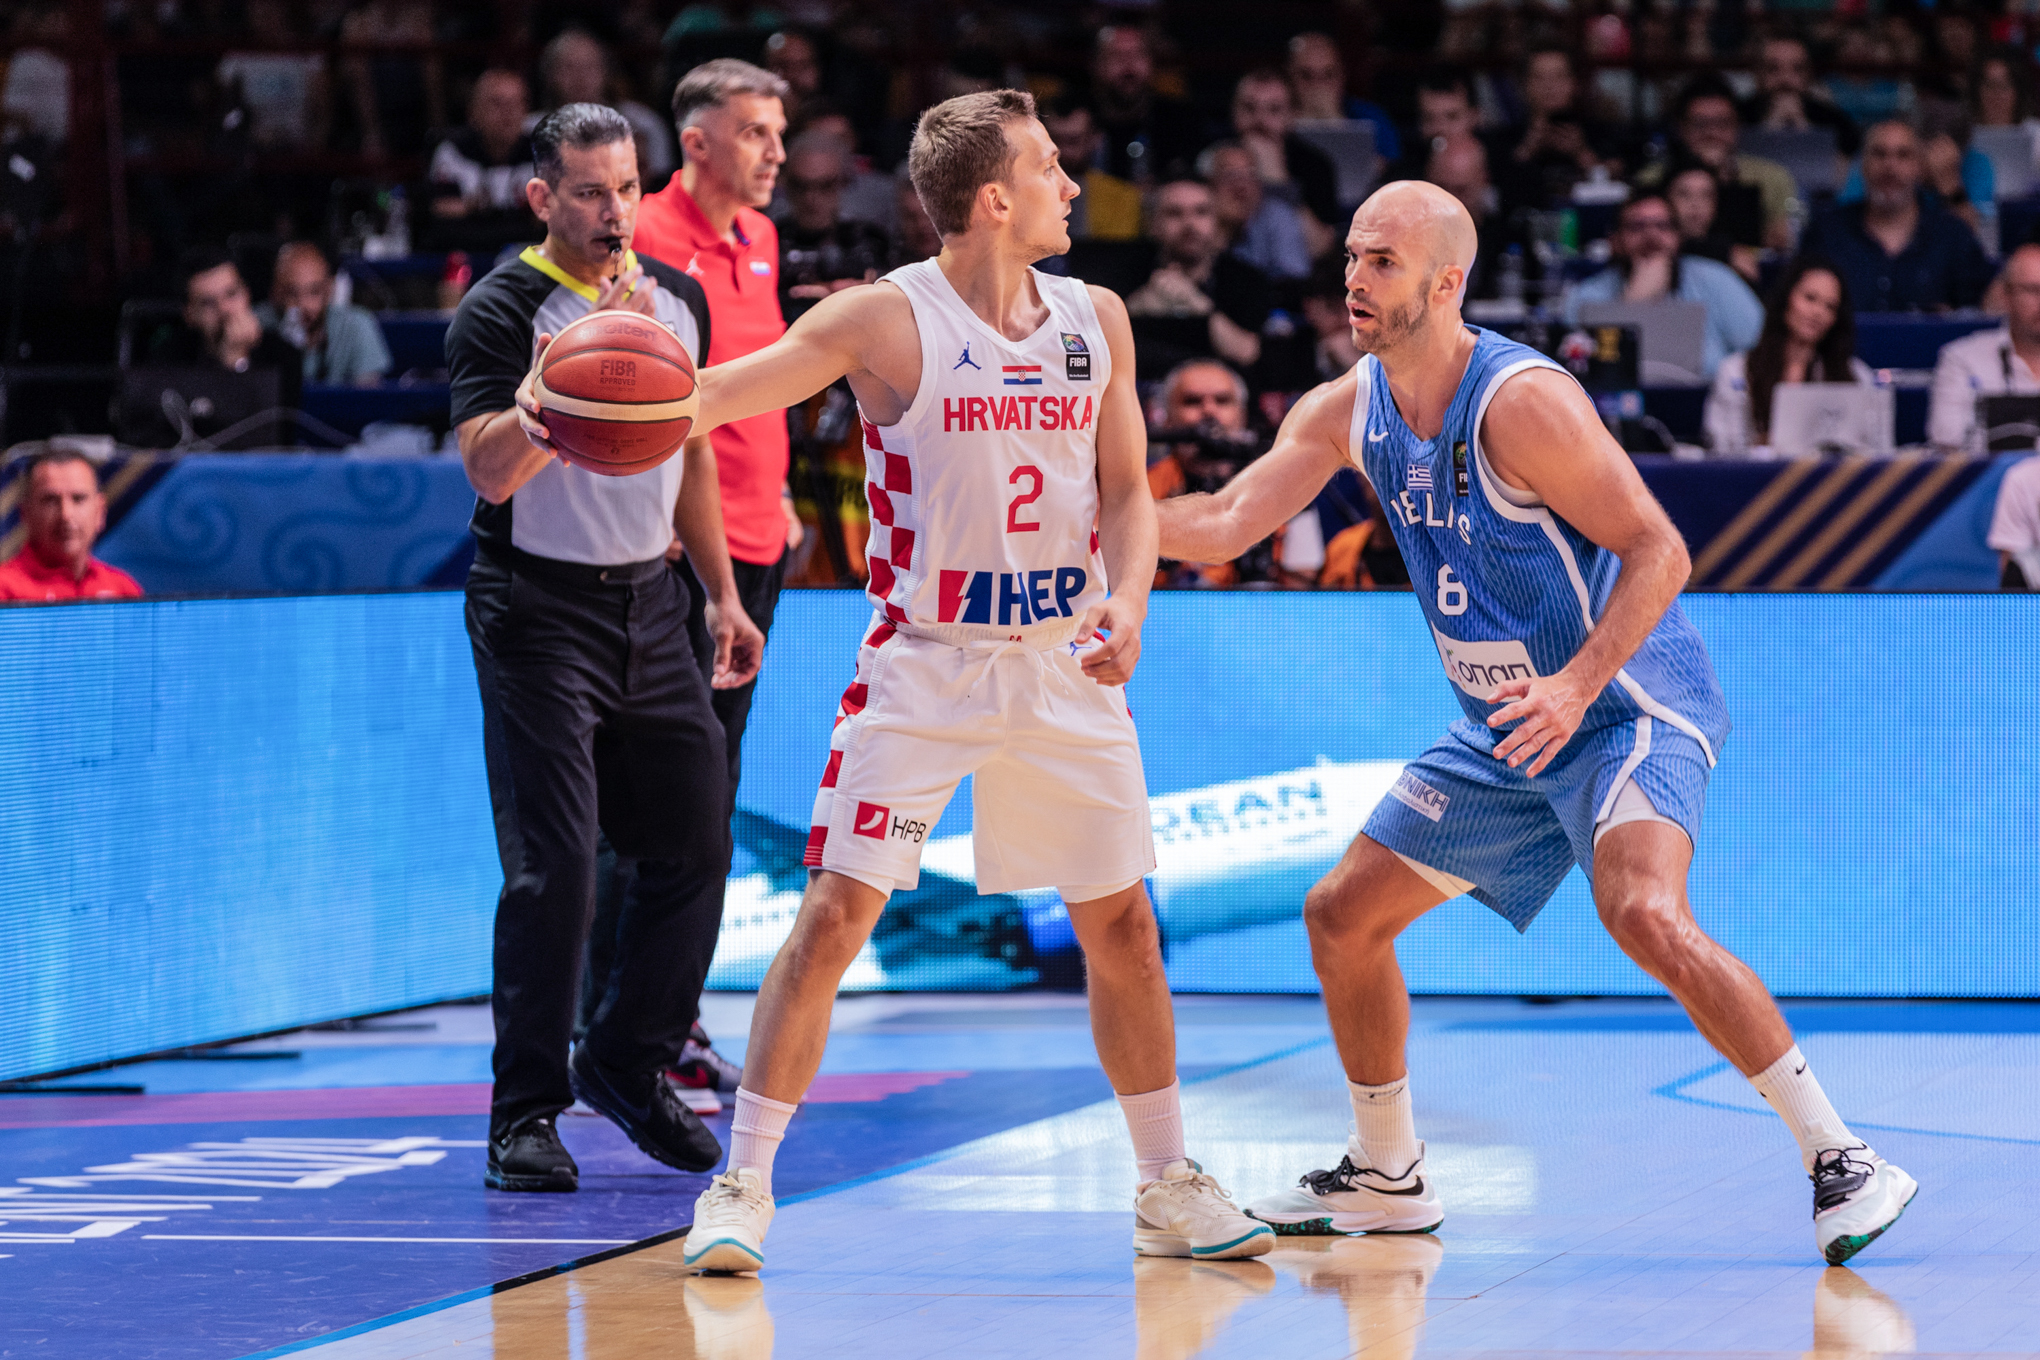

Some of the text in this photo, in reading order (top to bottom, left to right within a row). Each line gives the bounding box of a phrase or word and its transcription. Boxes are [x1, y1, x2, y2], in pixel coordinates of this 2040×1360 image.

[600, 359, 636, 377] FIBA
[1069, 357, 1087, 367] FIBA
[944, 395, 1093, 432] HRVATSKA
[1006, 465, 1044, 534] 2
[998, 566, 1087, 626] HEP
[1437, 563, 1469, 616] 6
[891, 815, 927, 843] HPB
